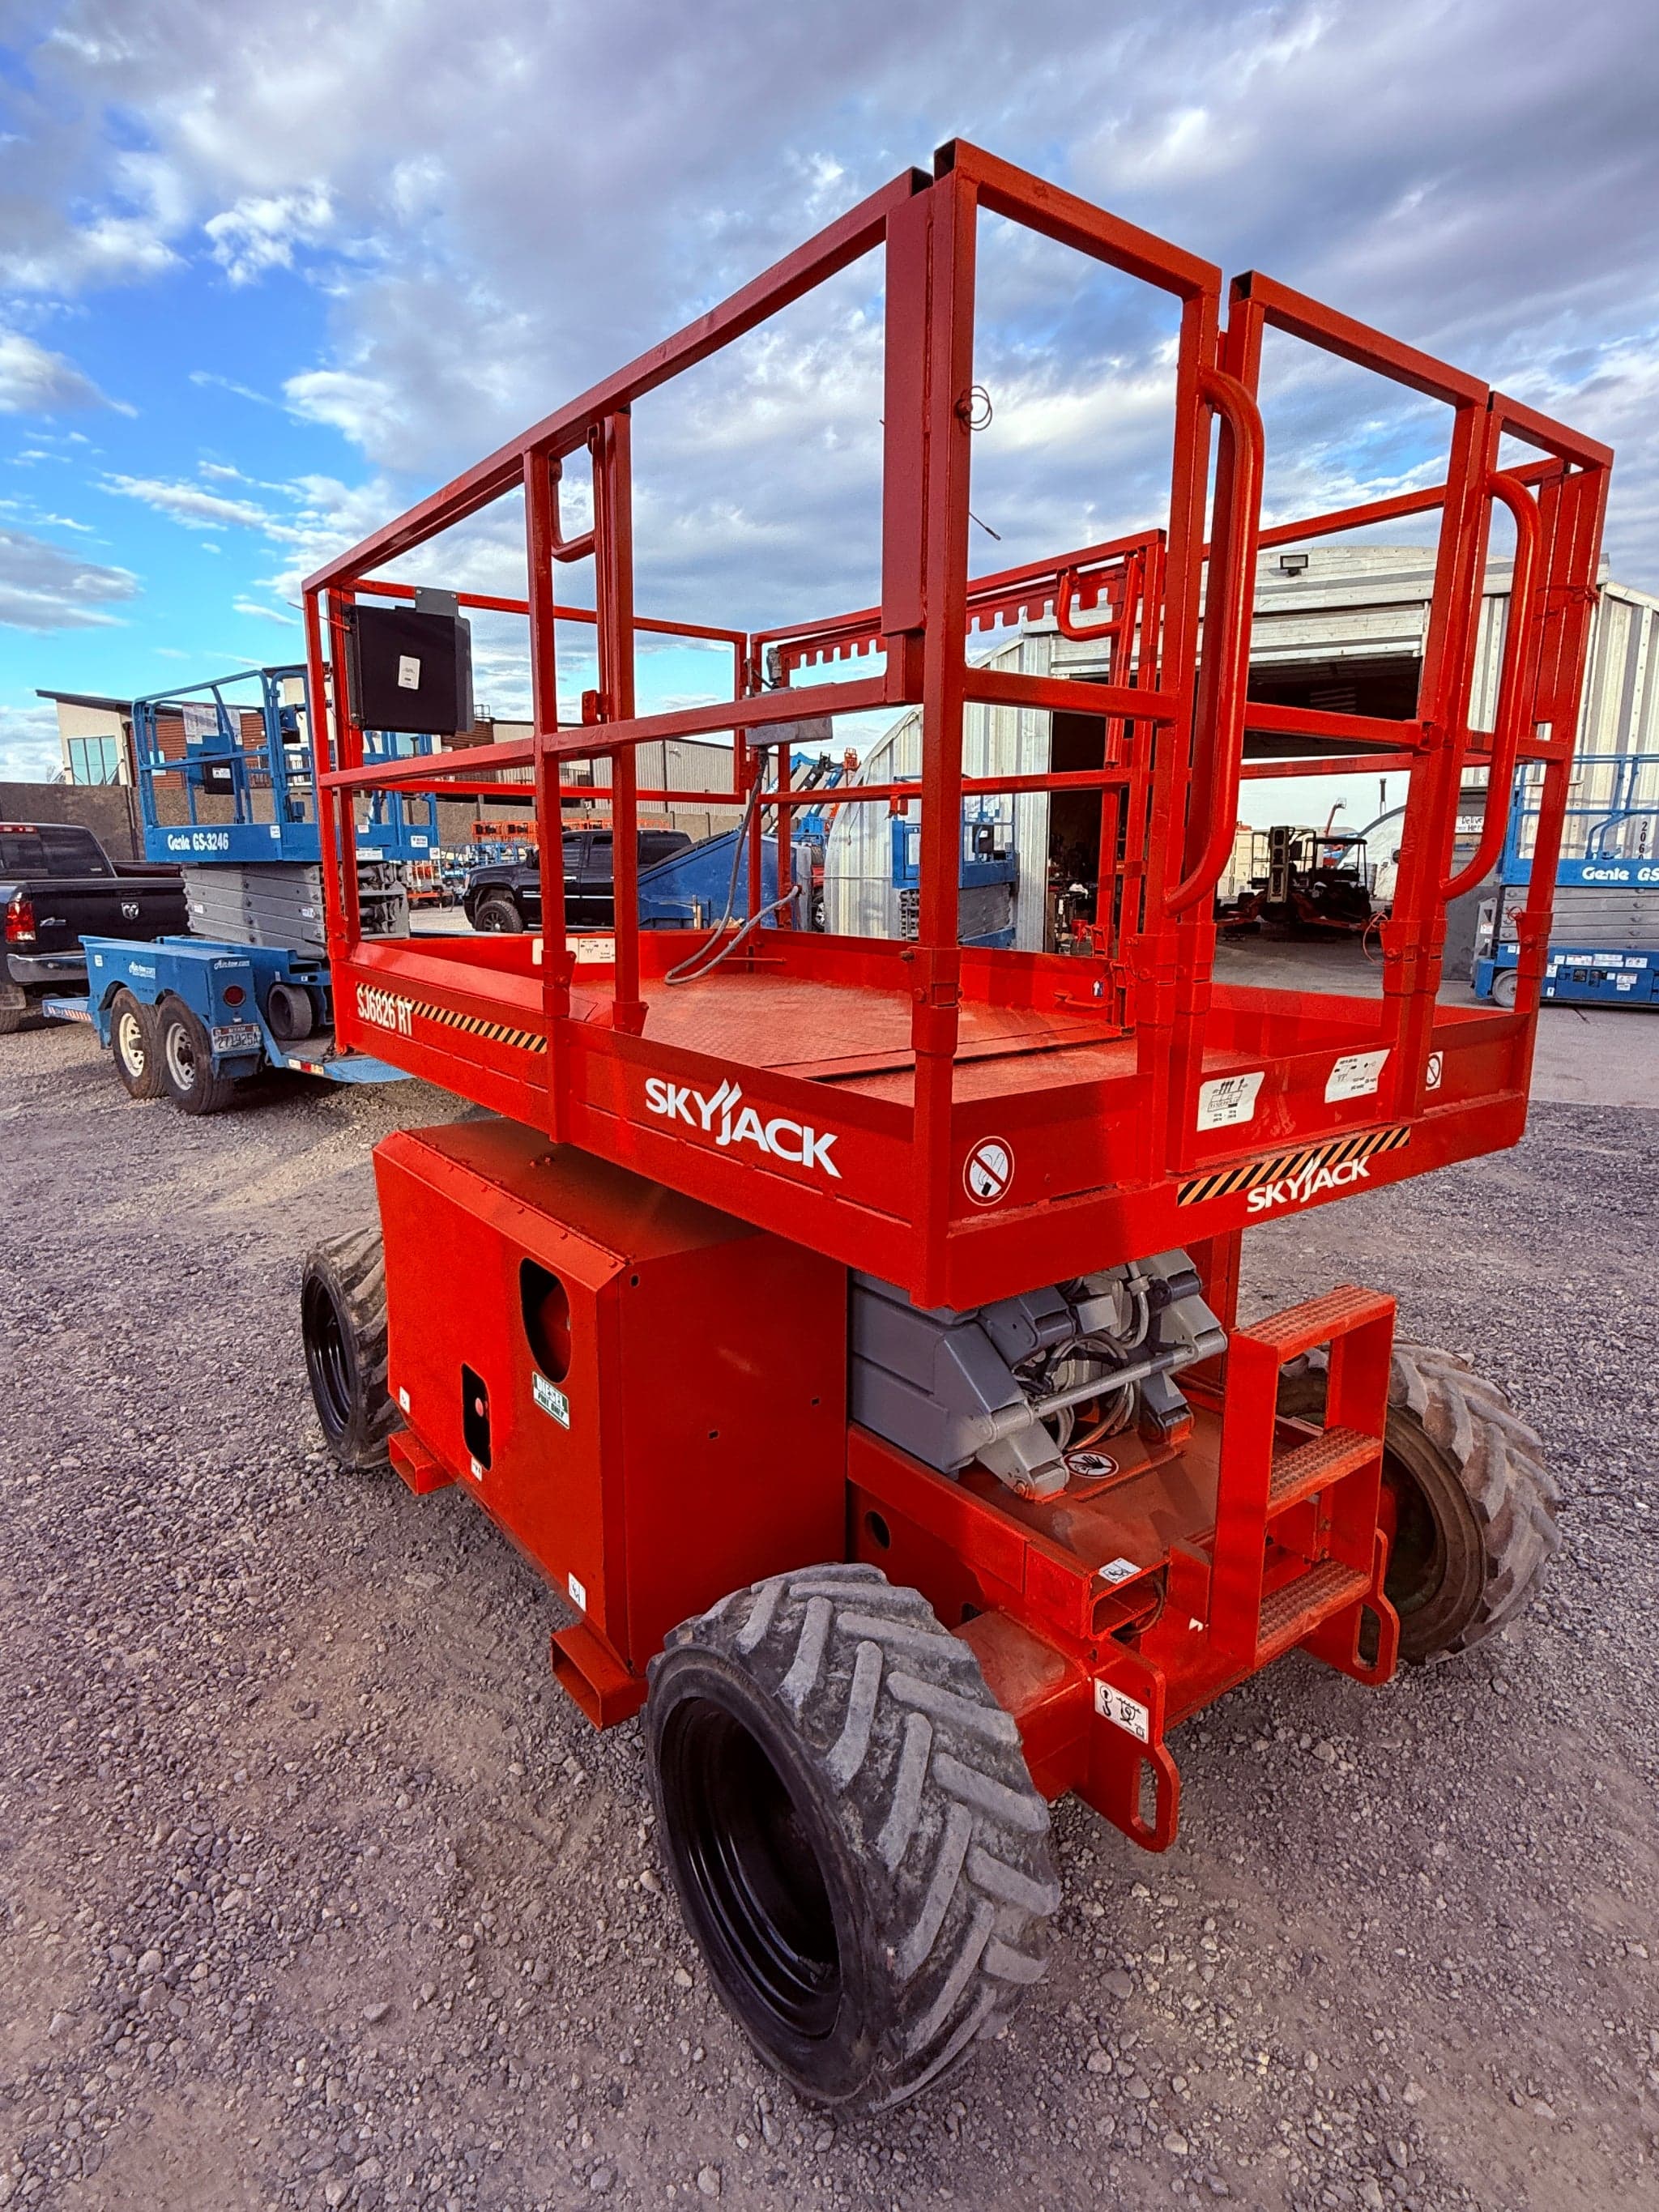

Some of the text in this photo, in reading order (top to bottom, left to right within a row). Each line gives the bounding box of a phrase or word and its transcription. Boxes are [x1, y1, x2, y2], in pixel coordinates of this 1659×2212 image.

[192, 832, 229, 851] GS-3246
[1582, 866, 1630, 881] Genie
[356, 987, 412, 1037] SJ6826 RT
[645, 1077, 843, 1179] SKYJACK
[1246, 1155, 1371, 1213] SKYJACK
